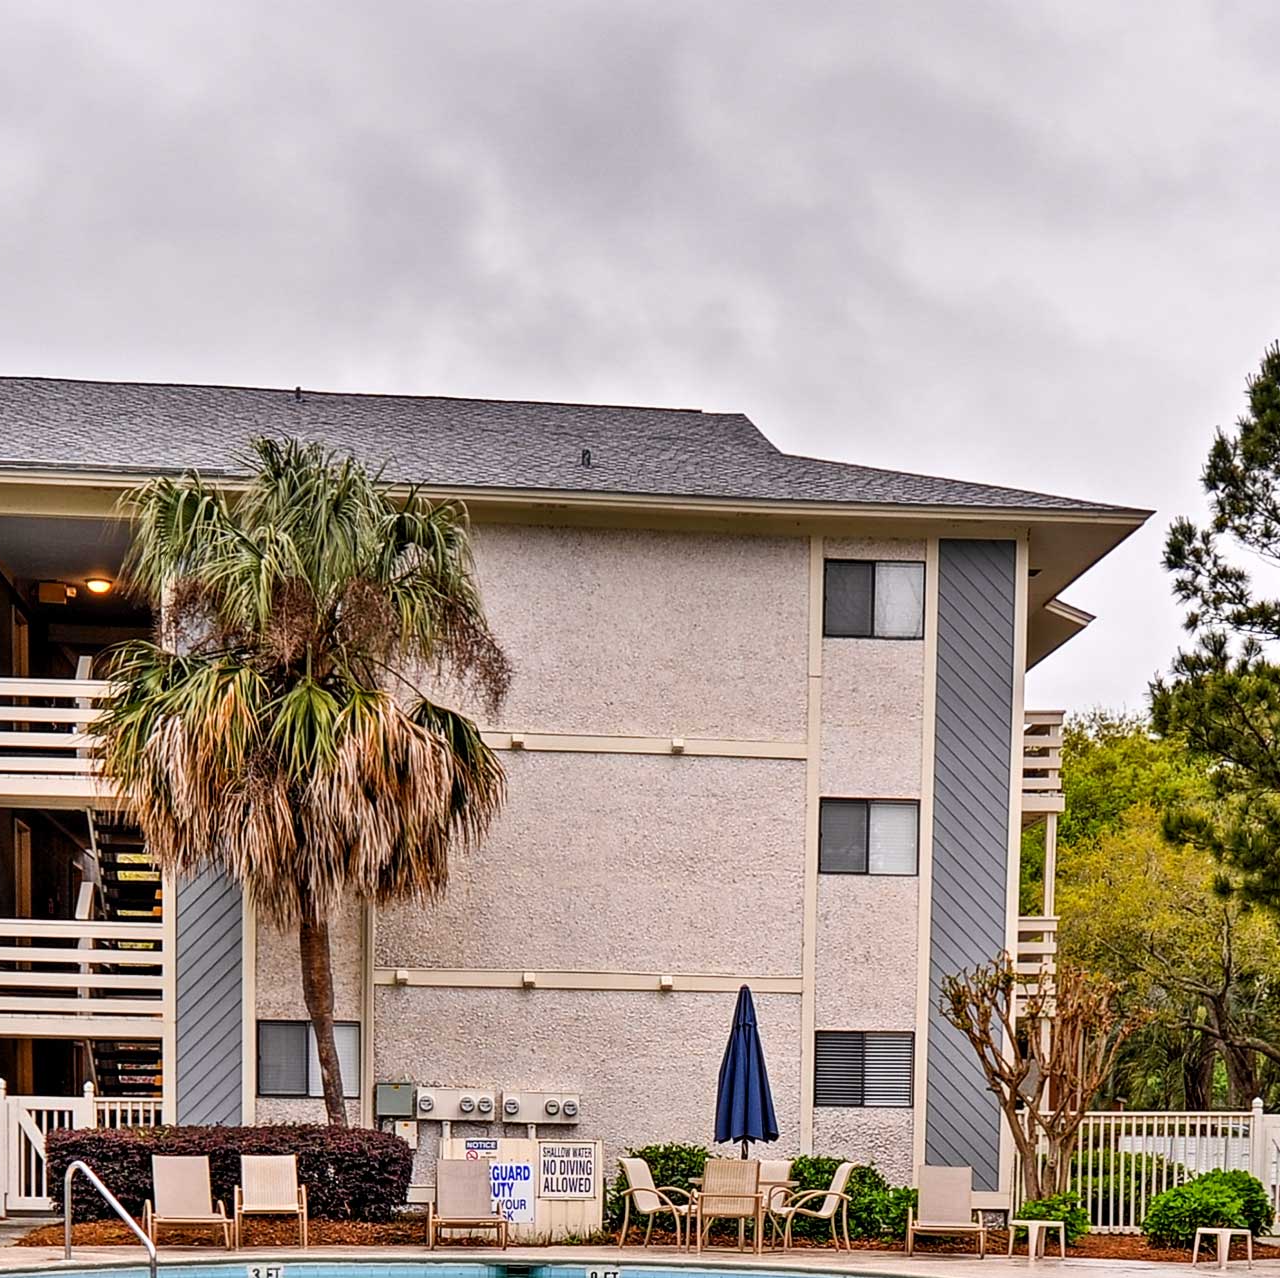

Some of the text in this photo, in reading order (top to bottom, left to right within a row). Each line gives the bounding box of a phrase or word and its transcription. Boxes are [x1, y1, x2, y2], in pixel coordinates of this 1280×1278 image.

[466, 1141, 496, 1149] NOTICE
[543, 1147, 592, 1158] SHALLOW WATER
[489, 1165, 531, 1181] GUARD
[543, 1159, 592, 1176] NO DIVING
[490, 1182, 514, 1198] UTY
[543, 1177, 591, 1193] ALLOWED
